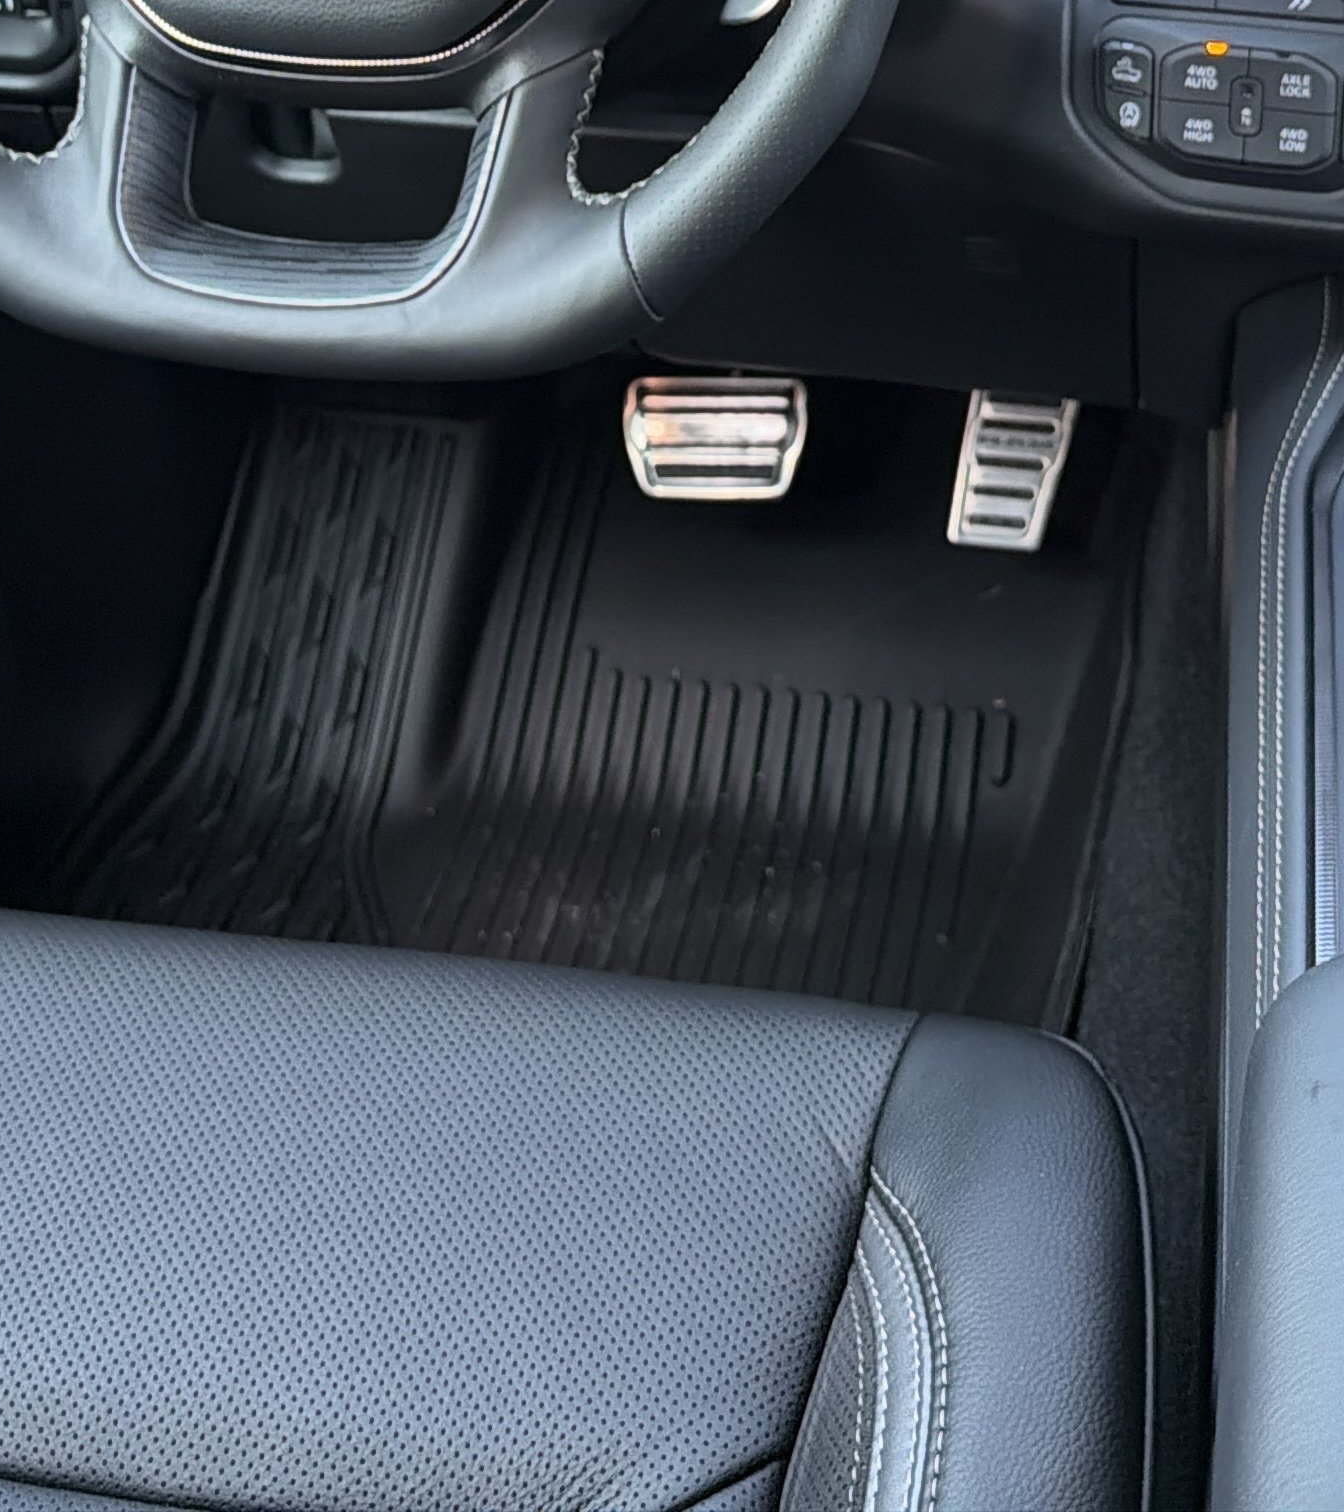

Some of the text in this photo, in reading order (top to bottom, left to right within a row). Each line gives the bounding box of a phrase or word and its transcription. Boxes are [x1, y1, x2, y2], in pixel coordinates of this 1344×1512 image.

[1186, 64, 1218, 78] 4WD
[1184, 76, 1218, 91] AUTO
[1280, 72, 1312, 86] AXLE
[1279, 85, 1312, 99] LOCK
[1185, 117, 1214, 131] 4WD
[1182, 129, 1216, 144] HIGH
[1279, 126, 1309, 141] 4WD
[1277, 138, 1308, 154] LOW
